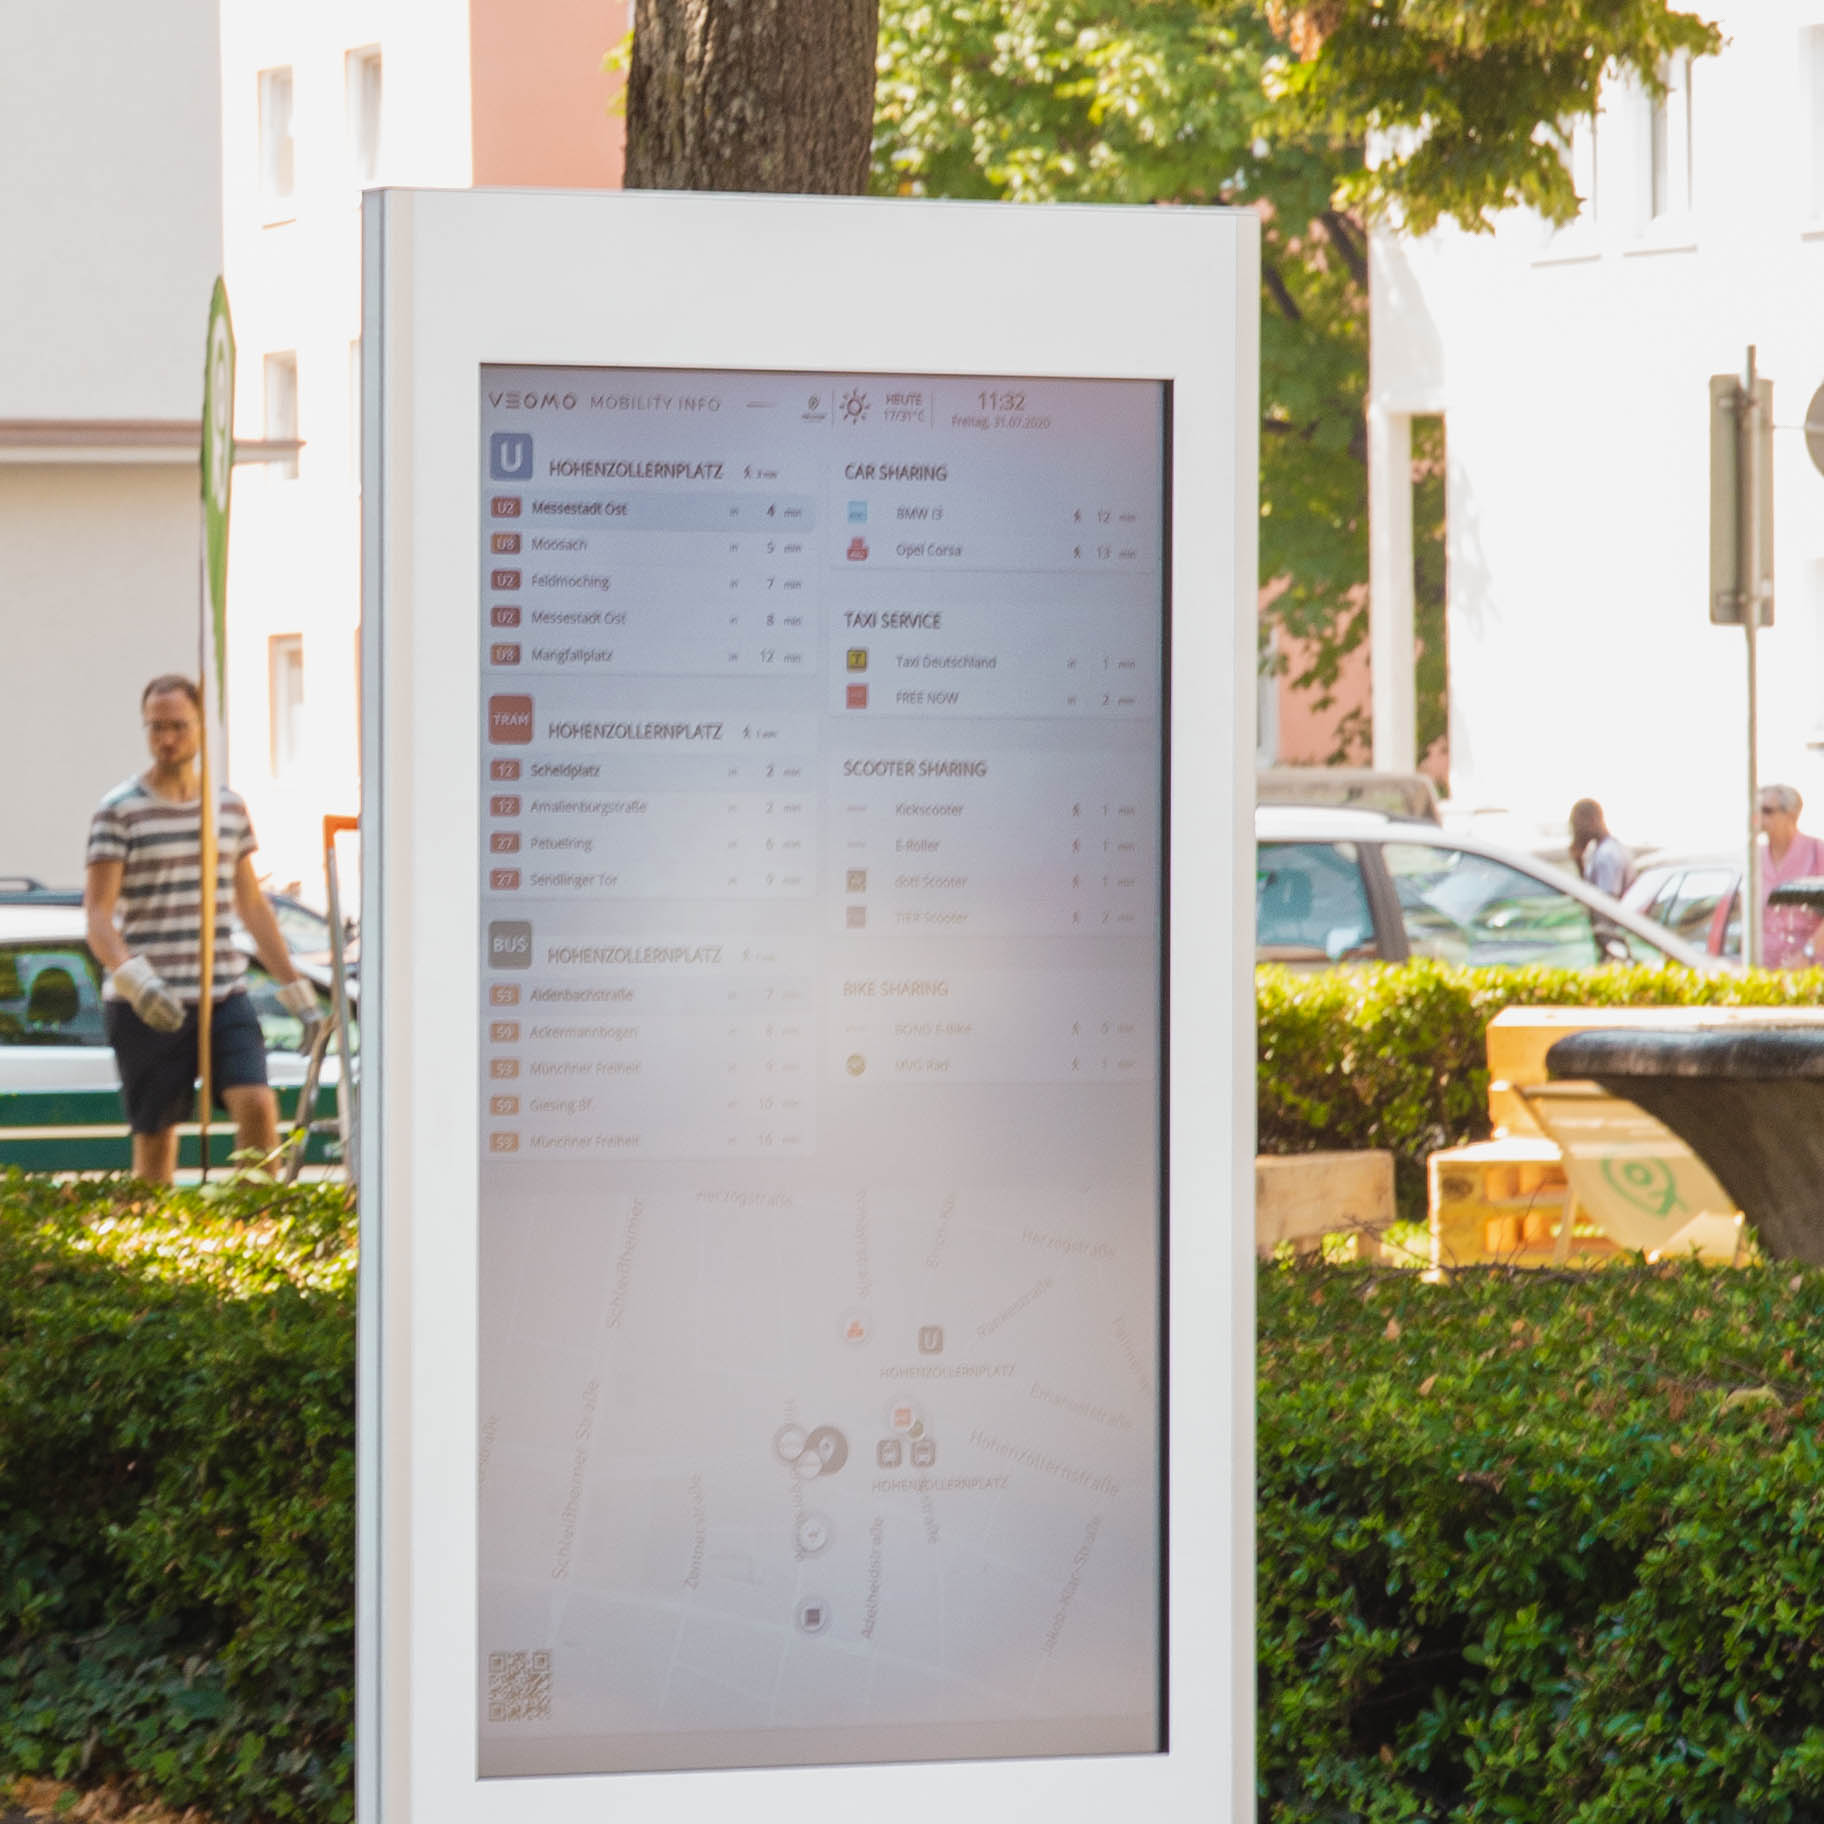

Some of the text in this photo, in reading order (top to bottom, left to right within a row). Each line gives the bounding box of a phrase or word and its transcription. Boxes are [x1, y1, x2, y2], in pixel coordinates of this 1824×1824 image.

[589, 395, 673, 412] MOBILITY
[677, 396, 721, 412] INFO
[978, 391, 1026, 412] 11:32
[500, 441, 523, 473] U
[549, 459, 724, 480] HOHENZOLLERNPLATZ
[844, 464, 948, 482] CAR SHARING
[497, 502, 514, 514] U2
[531, 501, 602, 516] Messestadt
[605, 502, 628, 516] Ost
[497, 574, 514, 587] U2
[531, 575, 610, 592] Feldmoching
[497, 611, 514, 623] U2
[844, 612, 941, 630] TAXI SERVICE
[923, 656, 996, 670] Deutschland
[896, 692, 924, 705] FREE
[927, 692, 959, 705] NOW
[493, 713, 529, 726] TRAM
[548, 722, 724, 740] HOHENZOLLERNPLATZ
[498, 764, 513, 777] 12
[843, 760, 988, 778] SCOOTER SHARING
[493, 936, 528, 953] BUS
[547, 947, 723, 965] HOHENZOLLERNPLATZ
[843, 980, 949, 998] BIKE SHARING
